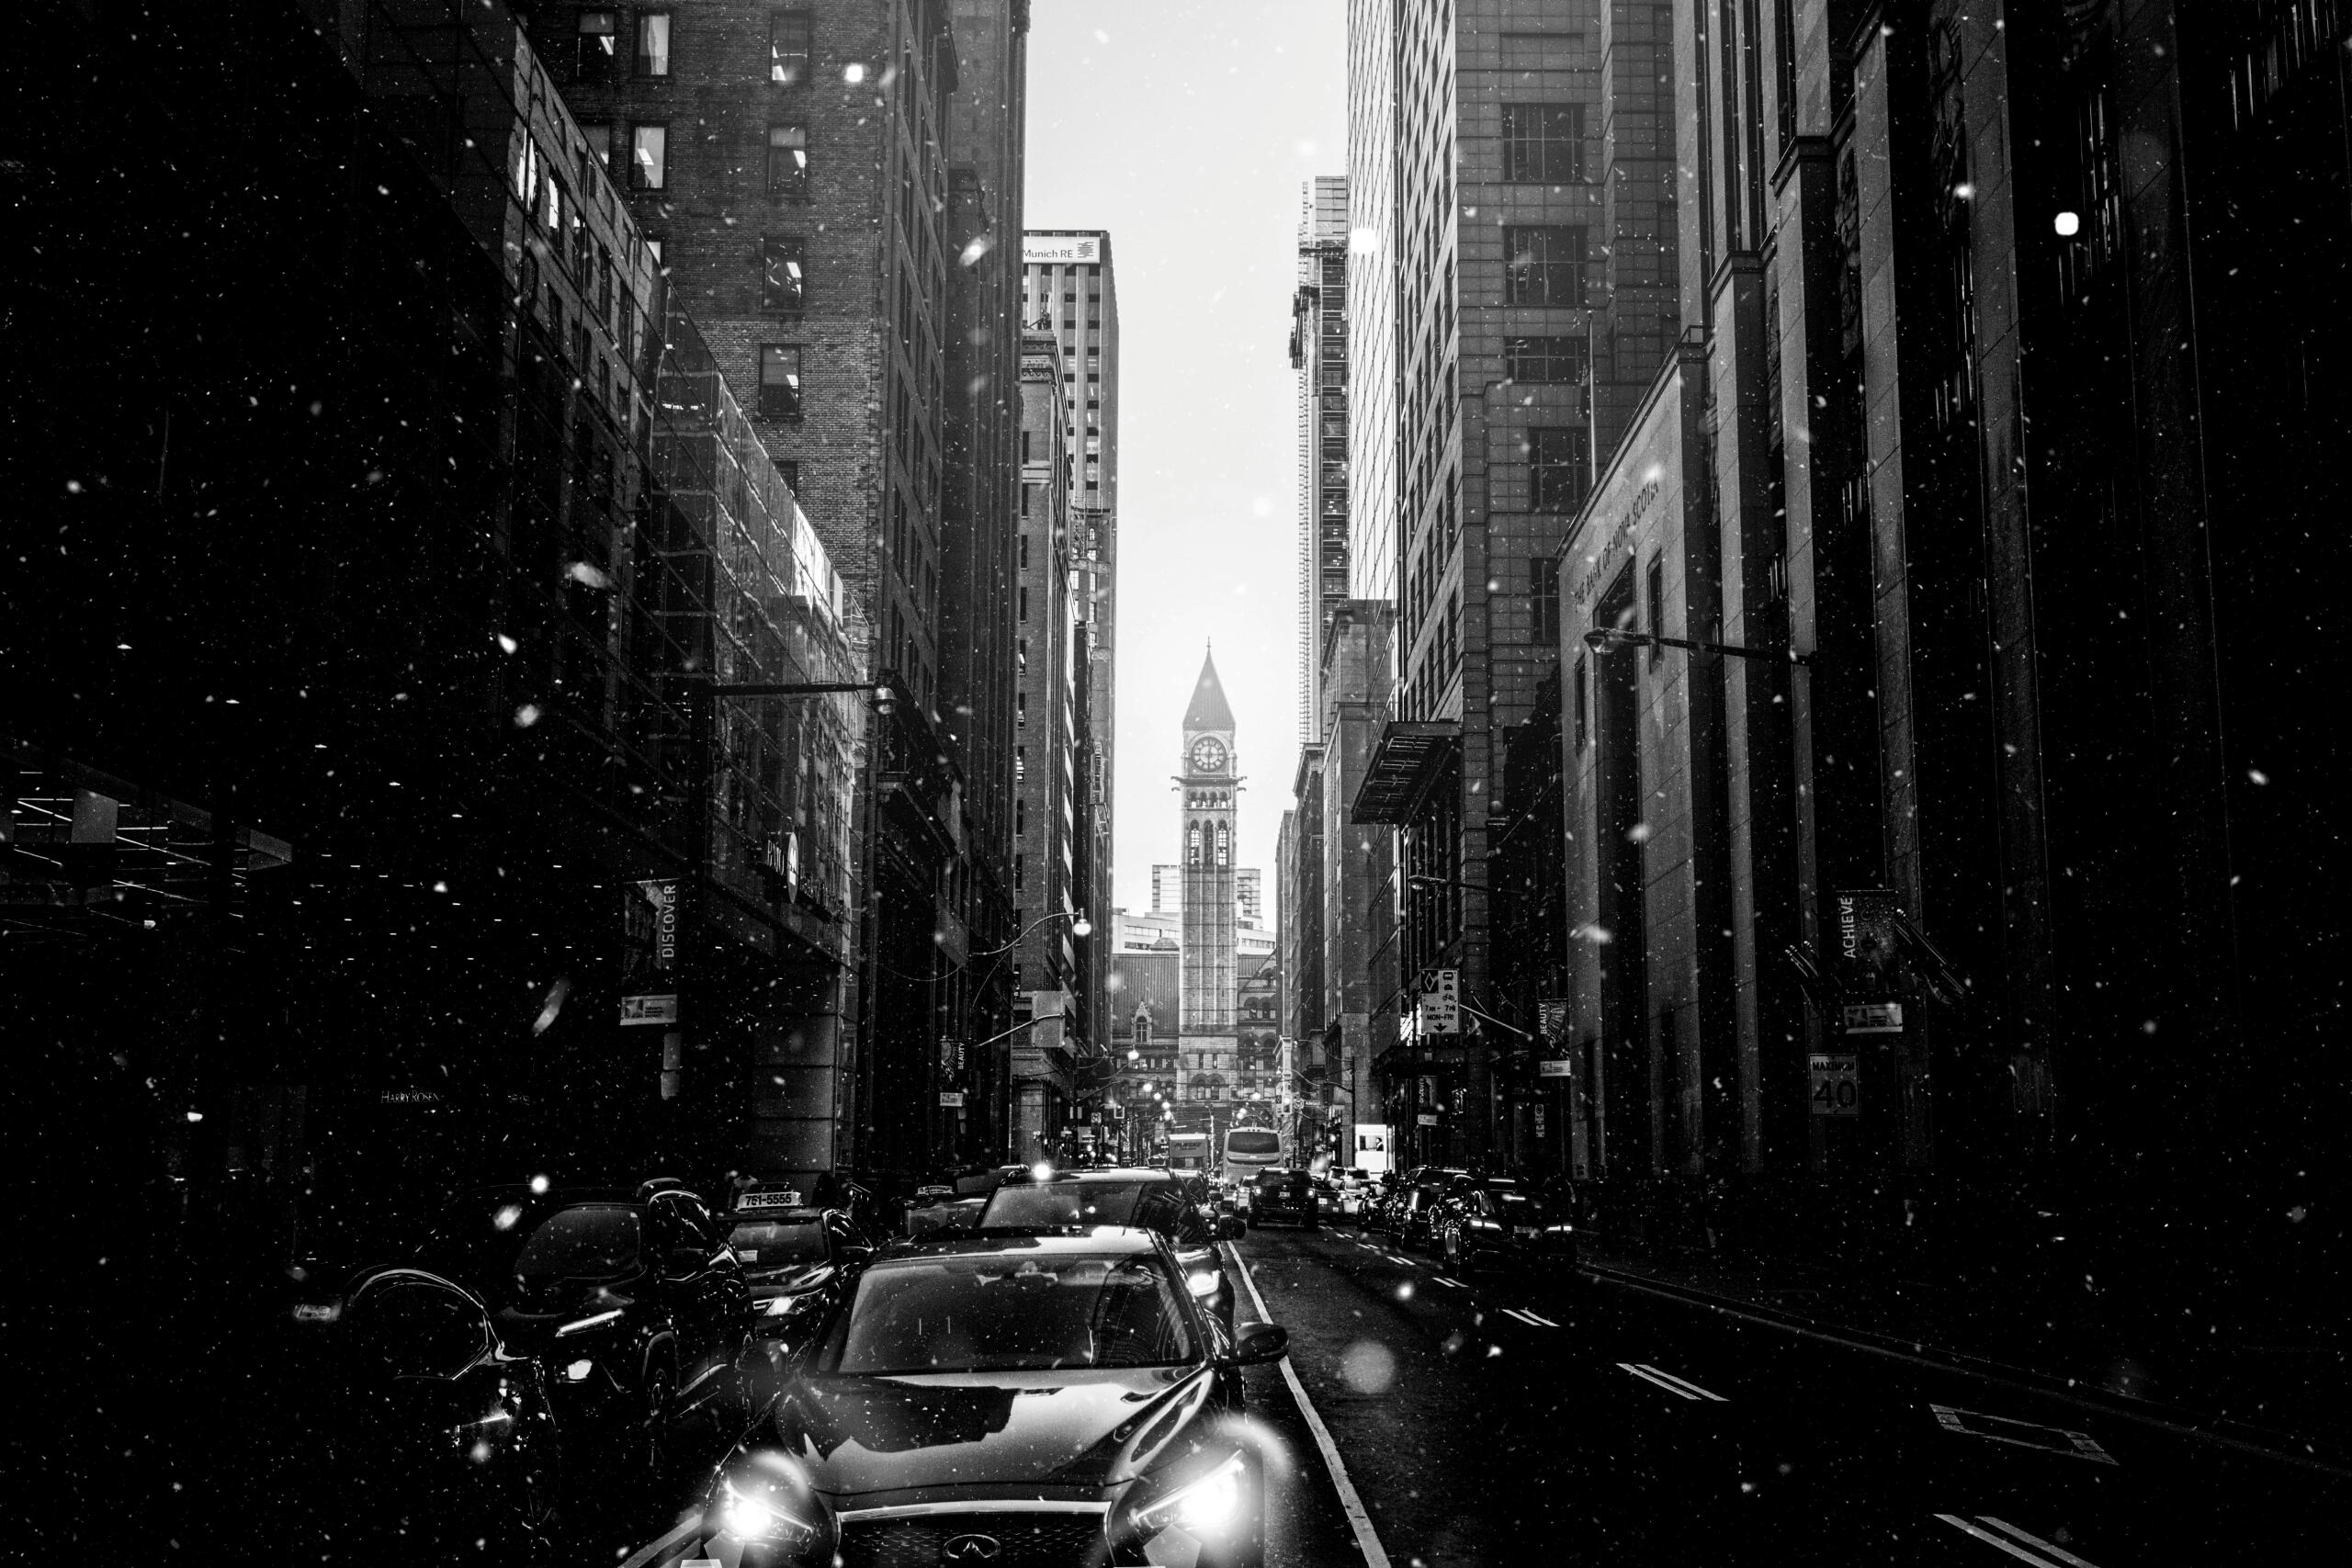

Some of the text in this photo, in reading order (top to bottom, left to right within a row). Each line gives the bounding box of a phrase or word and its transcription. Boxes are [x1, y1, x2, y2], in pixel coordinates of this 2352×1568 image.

[1023, 250, 1073, 258] Munich RE
[1602, 542, 1611, 570] OF
[1612, 513, 1631, 557] NOVA
[662, 885, 676, 959] DISCOVER
[1840, 897, 1857, 959] ACHIEVE
[1539, 1003, 1547, 1034] BEAUTY
[1812, 1061, 1855, 1072] MAXIMUM
[380, 1089, 440, 1103] HARRY ROSEN
[1814, 1080, 1857, 1108] 40
[745, 1193, 792, 1206] 751-5555
